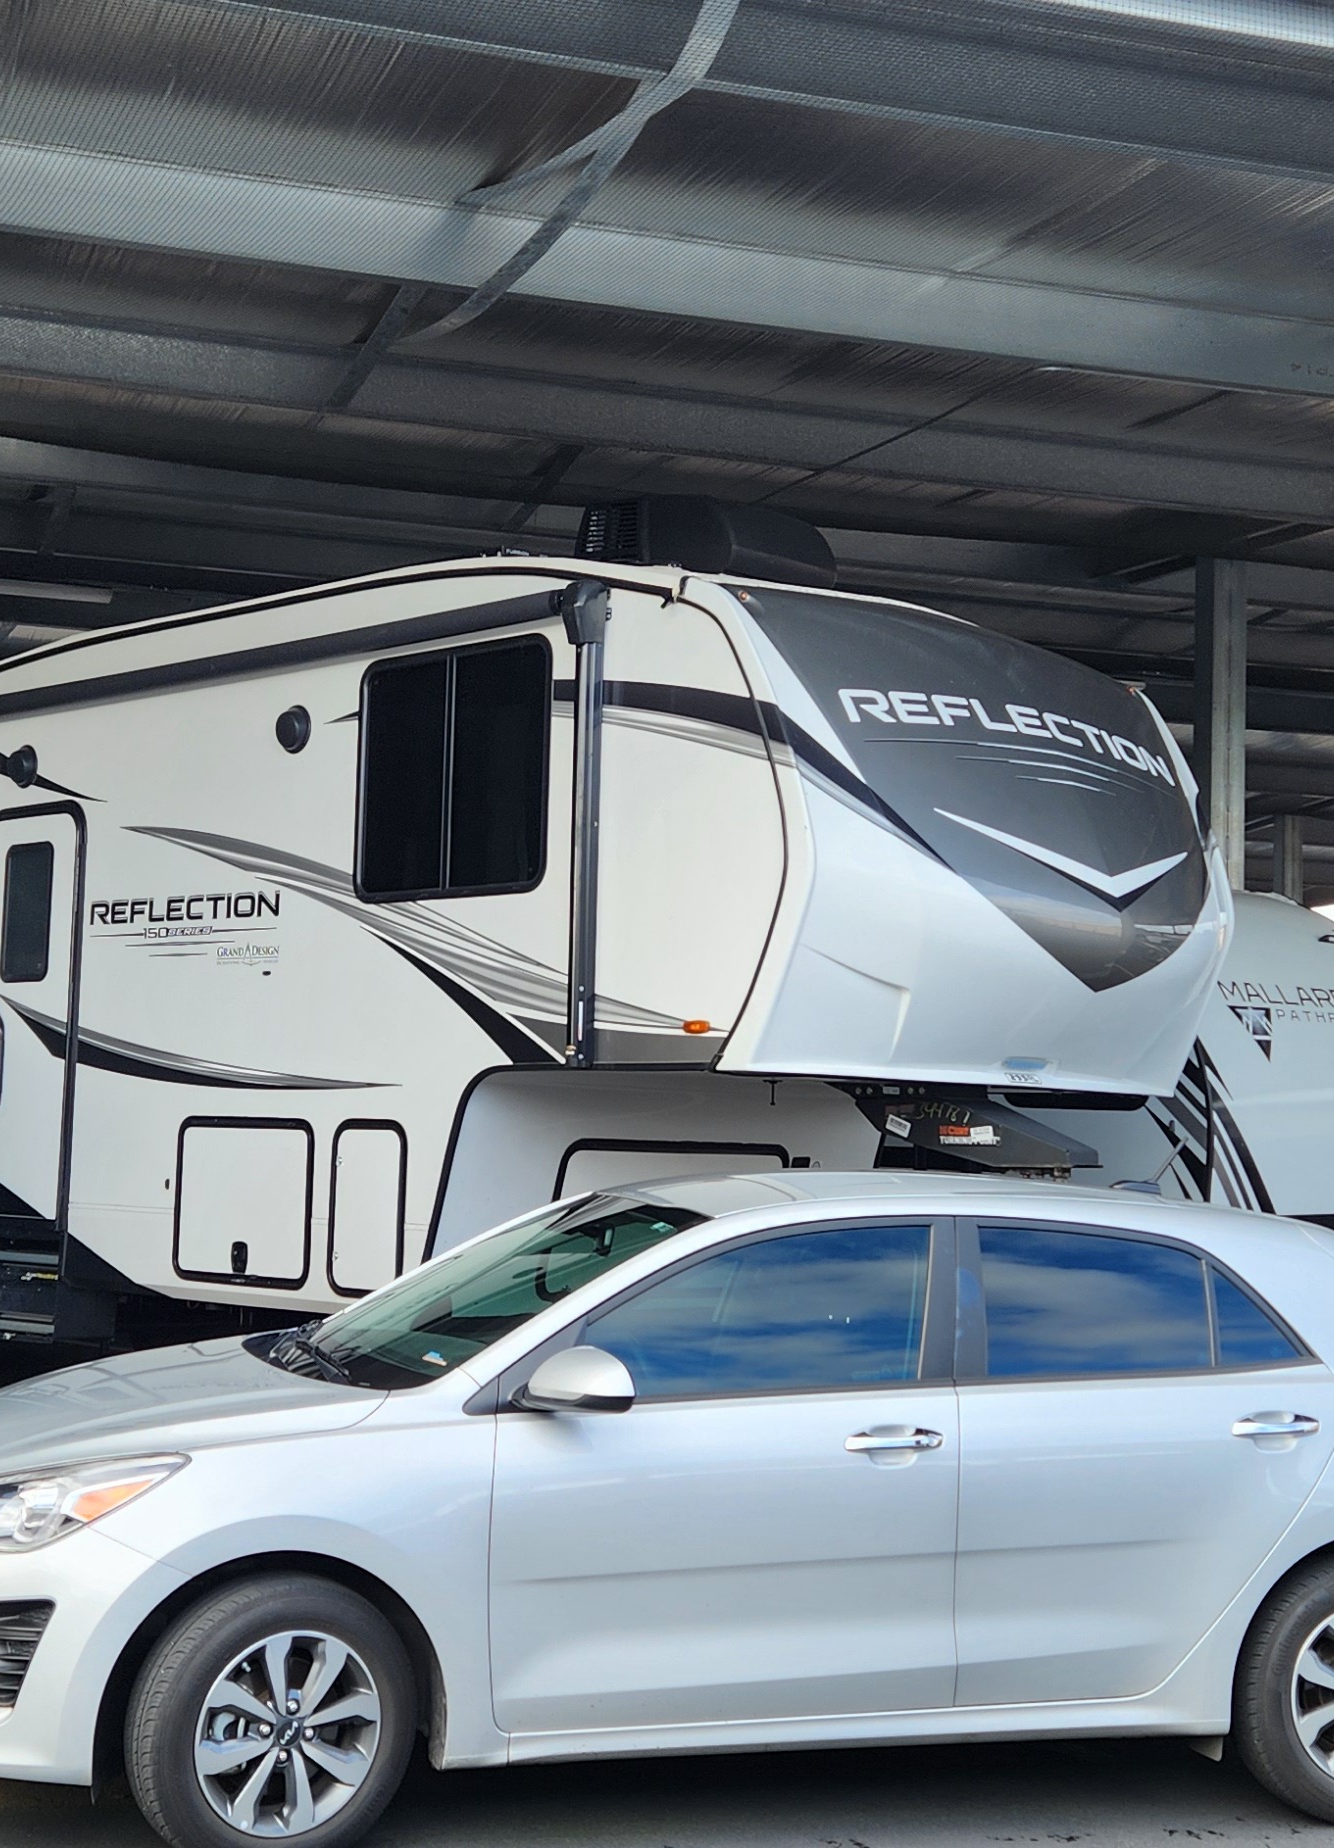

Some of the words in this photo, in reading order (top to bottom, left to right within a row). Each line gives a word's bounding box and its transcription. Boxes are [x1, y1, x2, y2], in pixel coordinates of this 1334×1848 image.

[837, 688, 1176, 787] REFLECTION
[89, 890, 281, 925] REFLECTION
[143, 927, 168, 939] 150
[168, 926, 214, 937] SERIES
[216, 946, 244, 957] GRAND
[251, 944, 280, 956] DESIGN
